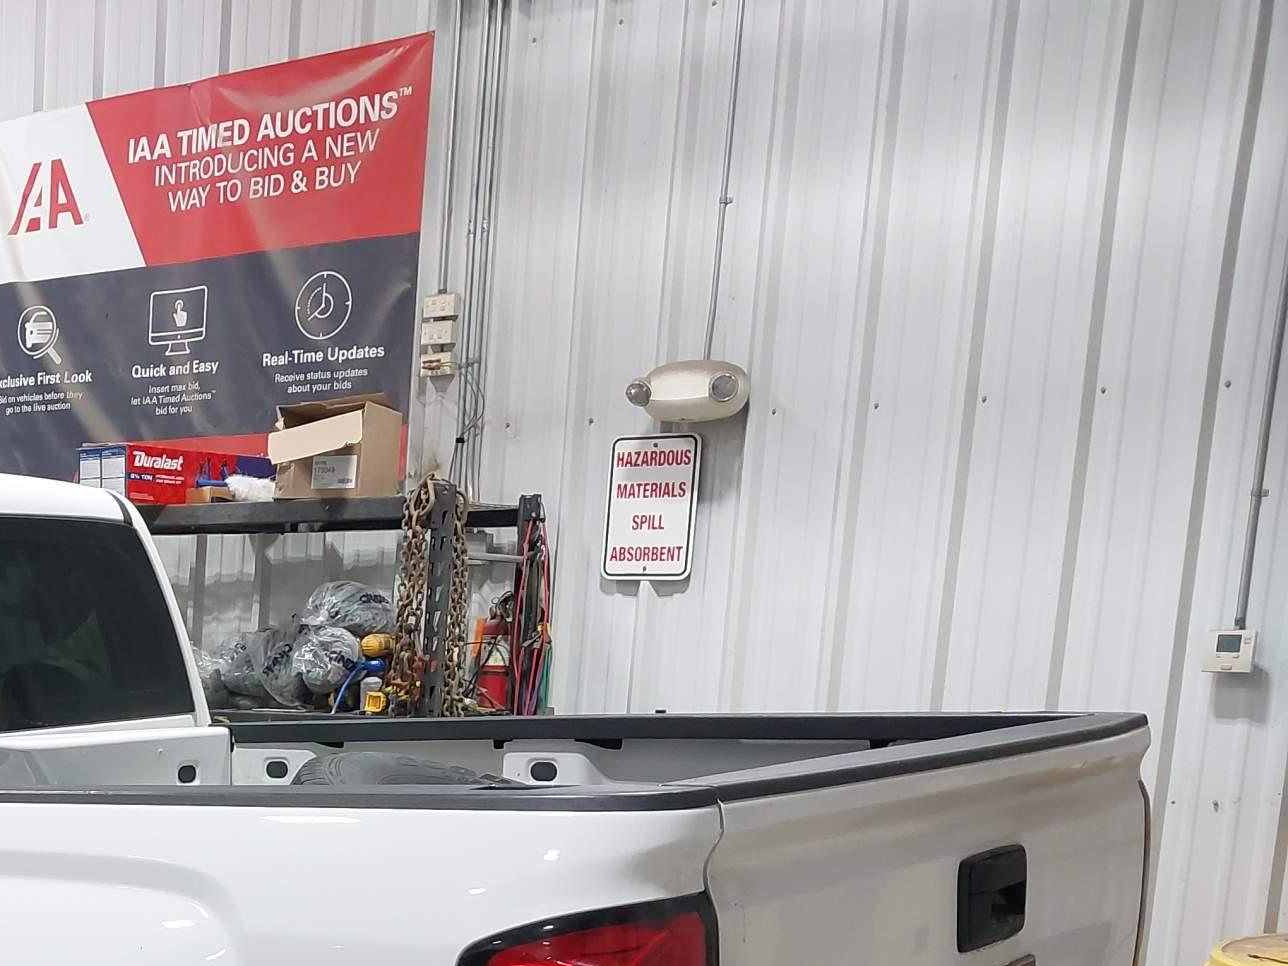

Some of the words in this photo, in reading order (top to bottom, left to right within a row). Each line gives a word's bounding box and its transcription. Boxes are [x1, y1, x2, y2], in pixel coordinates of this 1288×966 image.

[128, 134, 171, 163] IAA
[176, 118, 250, 156] TIMED
[155, 142, 294, 186] INTRODUCING
[301, 140, 318, 163] A
[326, 127, 380, 160] NEW
[168, 185, 210, 213] WAY
[216, 179, 241, 204] TO
[249, 172, 285, 200] BID
[291, 170, 308, 194] &
[315, 160, 362, 190] BUY
[262, 349, 324, 367] Real-Time
[327, 345, 385, 364] Updates
[37, 371, 61, 385] First
[63, 369, 92, 384] Look
[132, 363, 167, 378] Quick
[169, 361, 191, 376] and
[192, 359, 219, 374] Easy
[275, 373, 305, 384] Receive
[306, 370, 331, 380] status
[333, 368, 368, 380] updates
[149, 384, 170, 393] Insert
[171, 383, 186, 392] max
[287, 383, 310, 394] about
[312, 382, 332, 393] your
[333, 380, 352, 390] bids
[16, 392, 43, 402] vehicles
[44, 391, 65, 400] before
[66, 391, 84, 400] they
[131, 396, 141, 405] let
[142, 395, 158, 405] IAA
[158, 394, 181, 403] Timed
[5, 406, 13, 415] go
[22, 404, 32, 412] the
[33, 402, 46, 412] live
[47, 401, 70, 411] auction
[155, 406, 167, 415] bid
[169, 404, 179, 414] for
[180, 405, 192, 414] you
[133, 450, 184, 471] Duralast
[616, 449, 692, 467] HAZARDOUS
[616, 481, 687, 499] MATERIALS
[631, 514, 665, 531] SPILL
[609, 545, 683, 562] ABSORBENT
